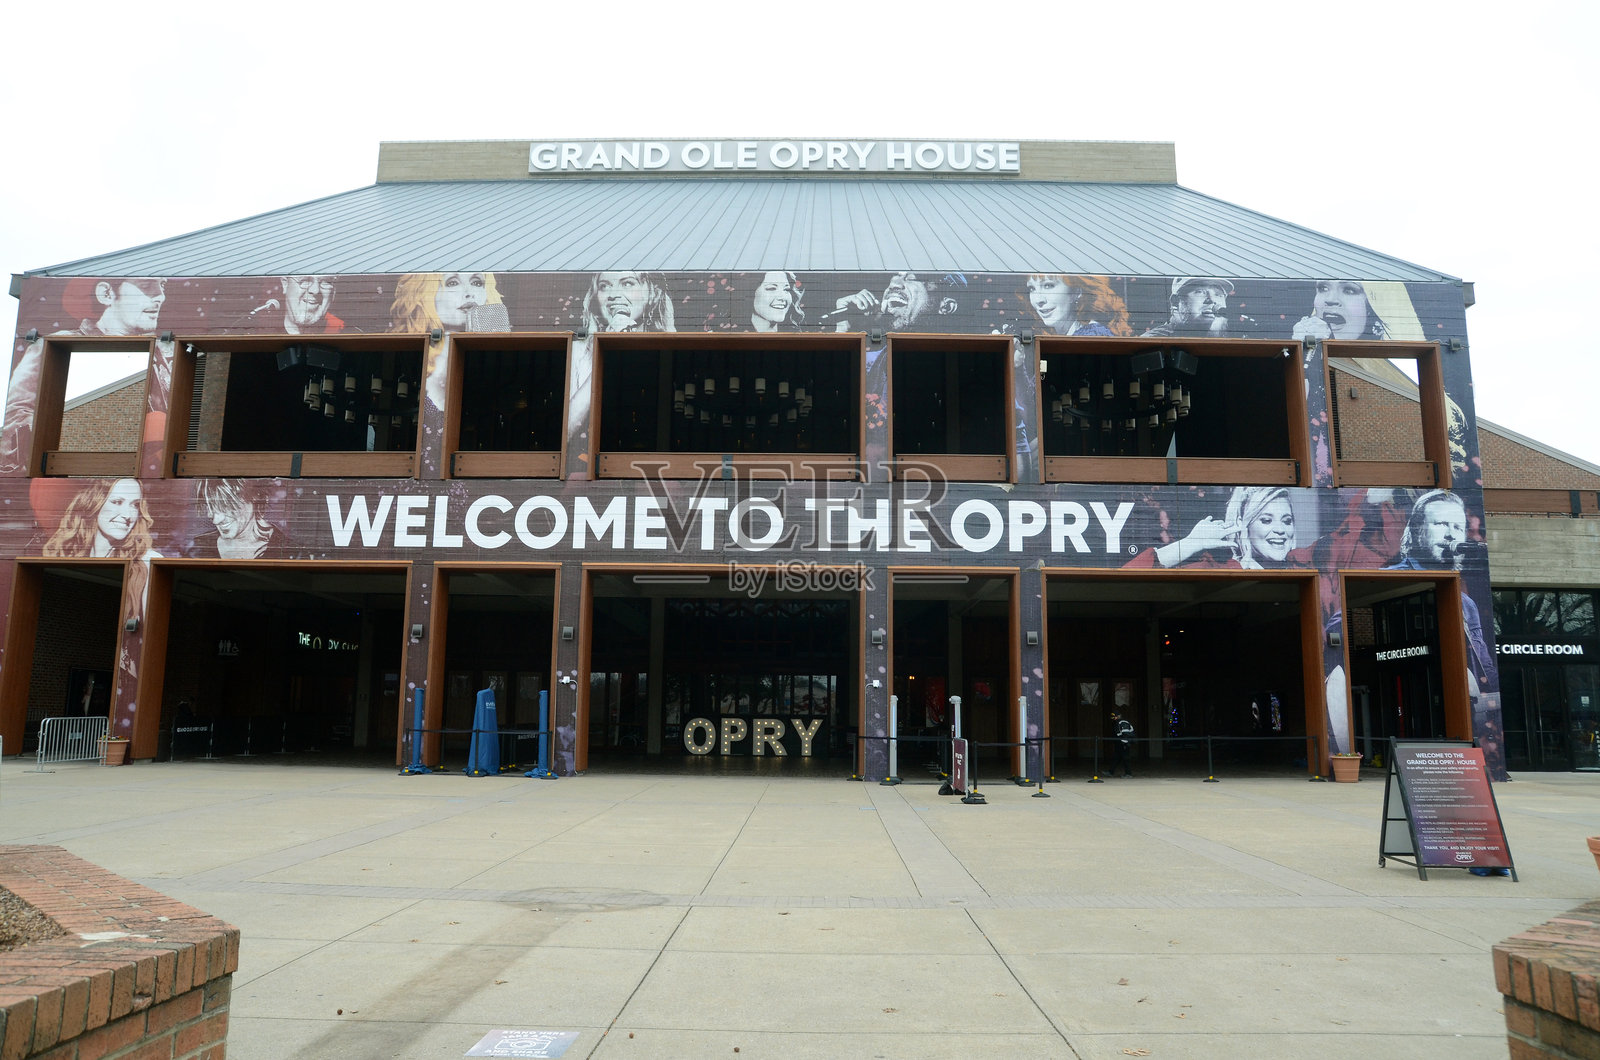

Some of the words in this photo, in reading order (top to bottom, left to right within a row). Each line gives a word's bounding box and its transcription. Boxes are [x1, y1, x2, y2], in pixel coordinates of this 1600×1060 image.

[530, 142, 671, 171] GRAND
[680, 141, 759, 170] OLE
[769, 140, 880, 170] OPRY
[886, 142, 1021, 172] HOUSE
[325, 494, 668, 550] WELCOME
[688, 496, 784, 552] TO
[804, 498, 932, 553] THE
[950, 499, 1136, 554] OPRY
[298, 631, 312, 646] THE
[1502, 643, 1543, 655] CIRCLE
[1544, 644, 1584, 655] ROOM
[1375, 651, 1387, 661] THE
[1386, 648, 1407, 660] CIRCLE
[1406, 645, 1430, 658] ROOM
[683, 717, 823, 757] OPRY
